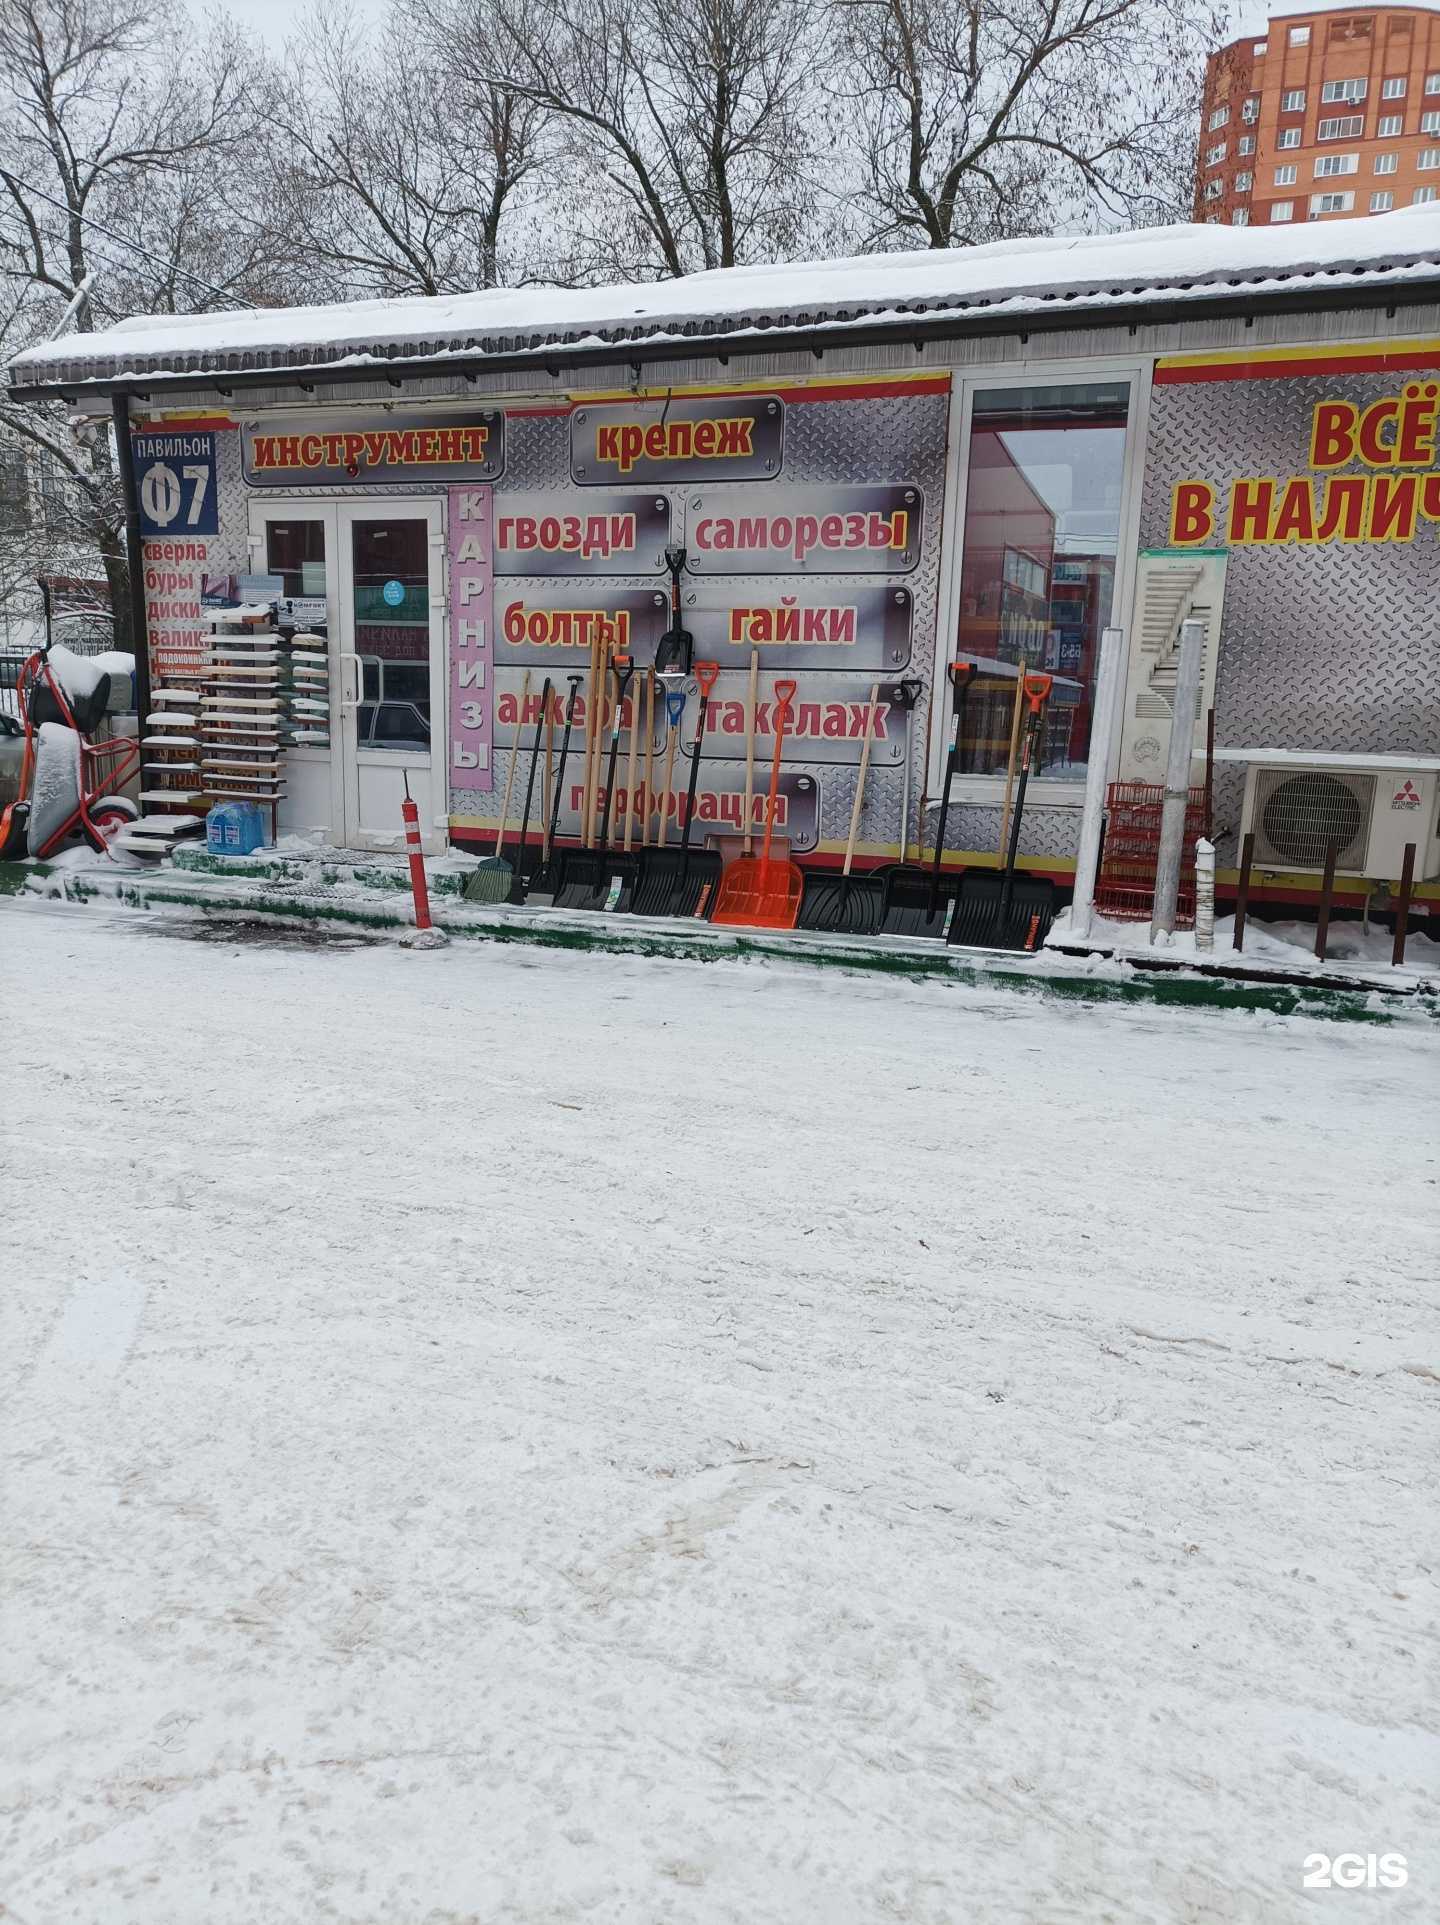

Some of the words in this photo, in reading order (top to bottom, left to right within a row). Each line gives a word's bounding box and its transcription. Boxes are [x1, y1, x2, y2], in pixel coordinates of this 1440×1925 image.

[597, 418, 757, 473] крепеж
[1310, 382, 1440, 467] ВСЁ
[136, 437, 212, 459] ПАВИЛЬОН
[252, 427, 489, 469] ИНСТРУМЕНТ
[140, 461, 210, 528] Ф7
[1172, 482, 1215, 544] В
[143, 542, 207, 567] сверла
[497, 514, 636, 559] гвозди
[694, 512, 908, 561] саморезы
[146, 567, 194, 595] буры
[147, 601, 201, 622] диски
[453, 492, 490, 771] КАРНИЗЫ
[503, 600, 630, 645] болты
[729, 596, 858, 643] гайки
[705, 701, 888, 739] такелаж
[570, 780, 788, 830] перфорация
